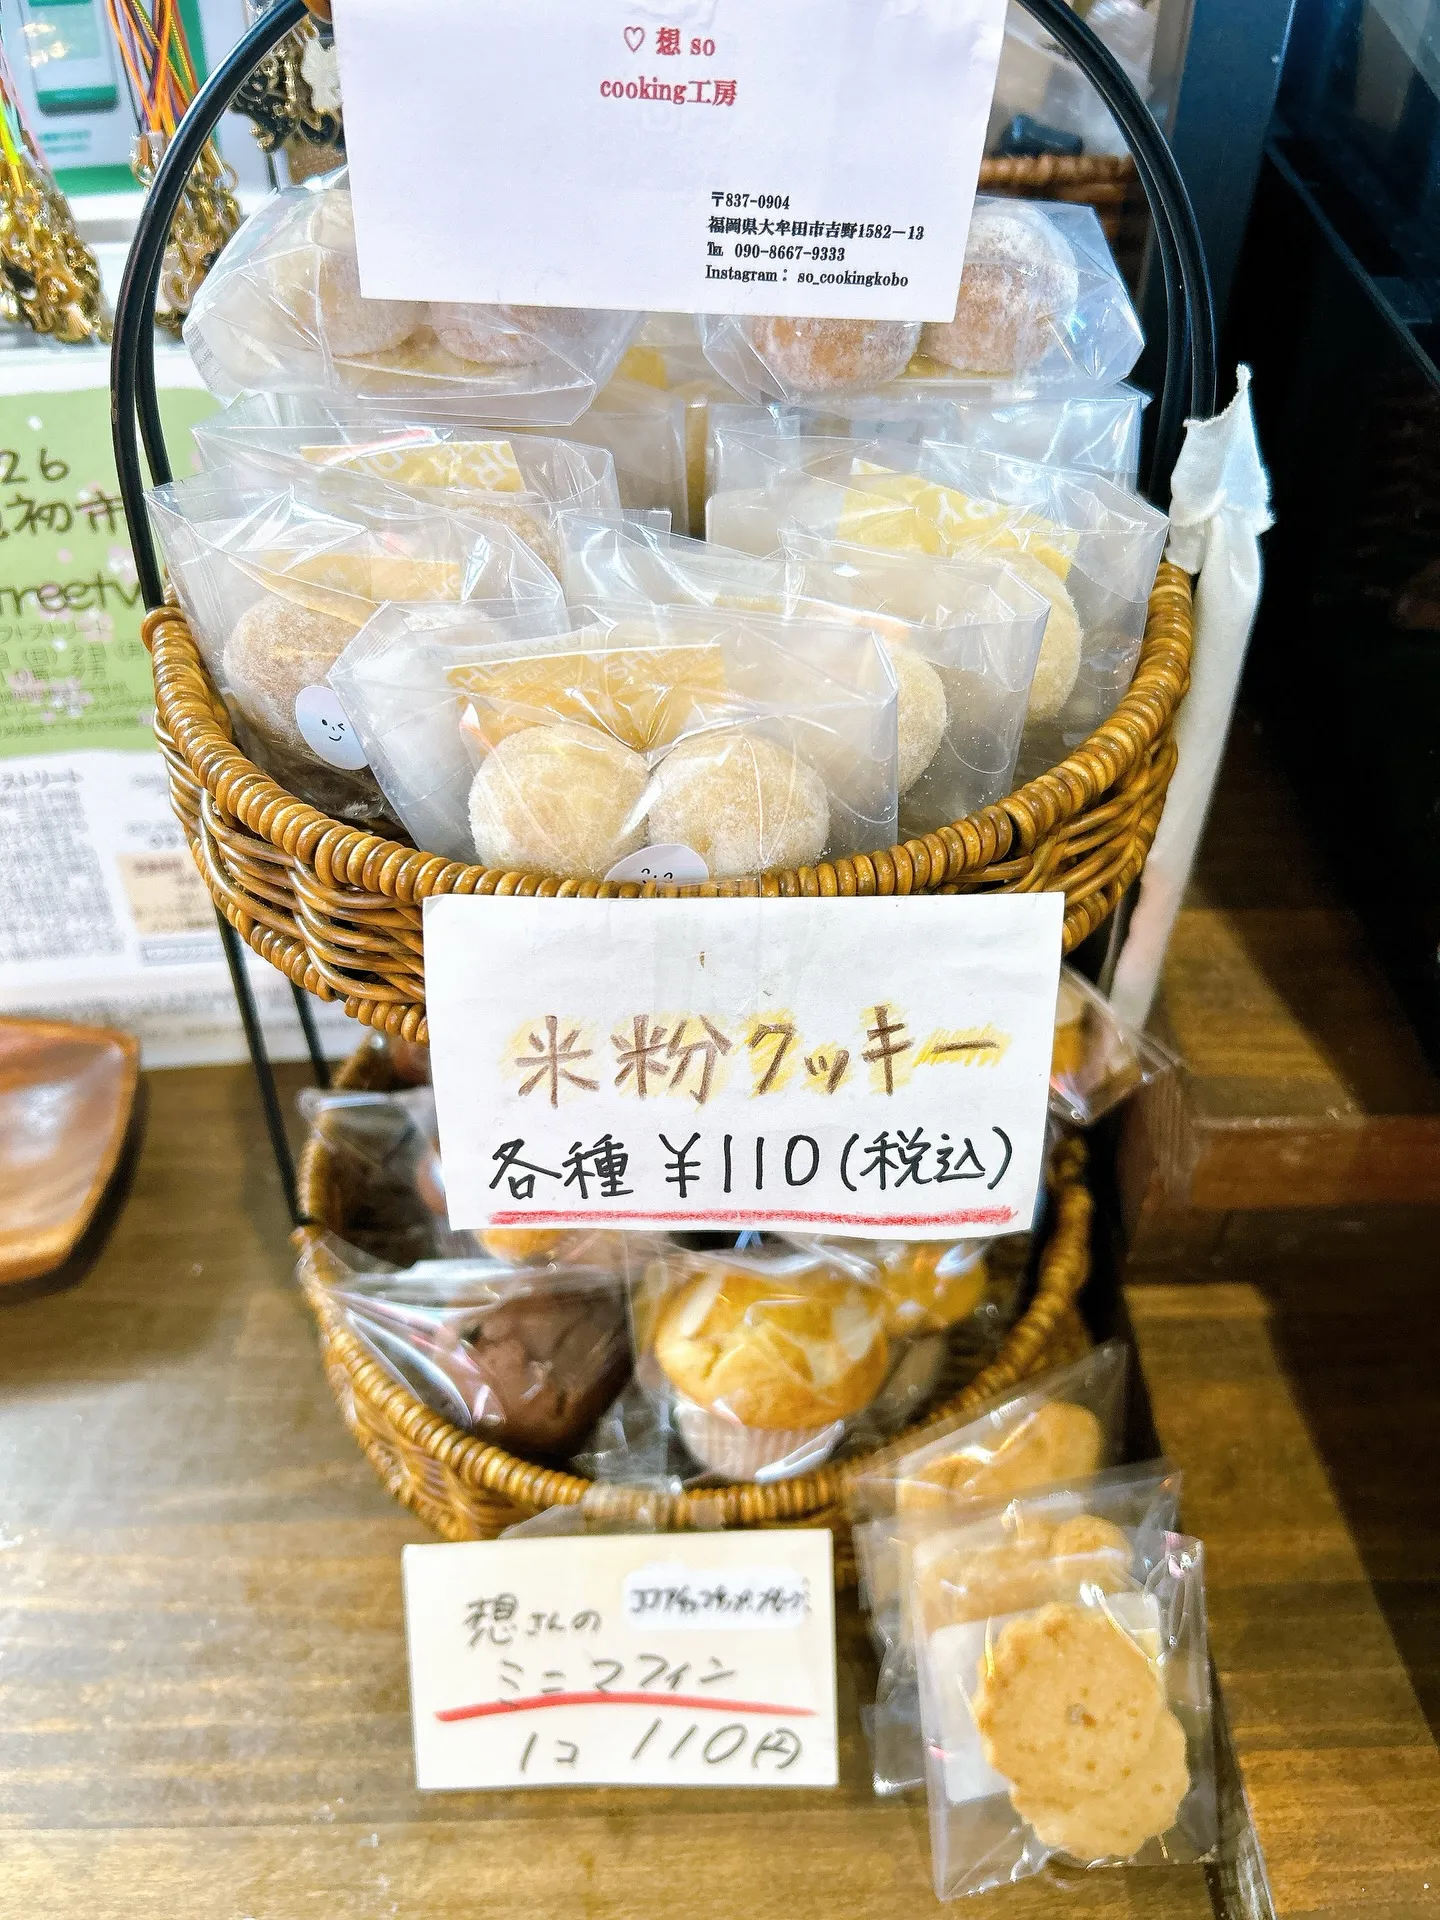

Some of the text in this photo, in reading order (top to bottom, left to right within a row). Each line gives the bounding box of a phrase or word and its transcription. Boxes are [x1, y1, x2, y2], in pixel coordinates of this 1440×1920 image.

[656, 27, 716, 56] 想 so
[599, 76, 738, 107] cooking工房
[734, 243, 846, 262] 090-8667-9333
[797, 270, 909, 288] so_cookingkobo
[514, 1005, 1001, 1109] 米粉クッキー
[487, 1135, 635, 1200] 各種
[631, 1716, 804, 1771] 110円
